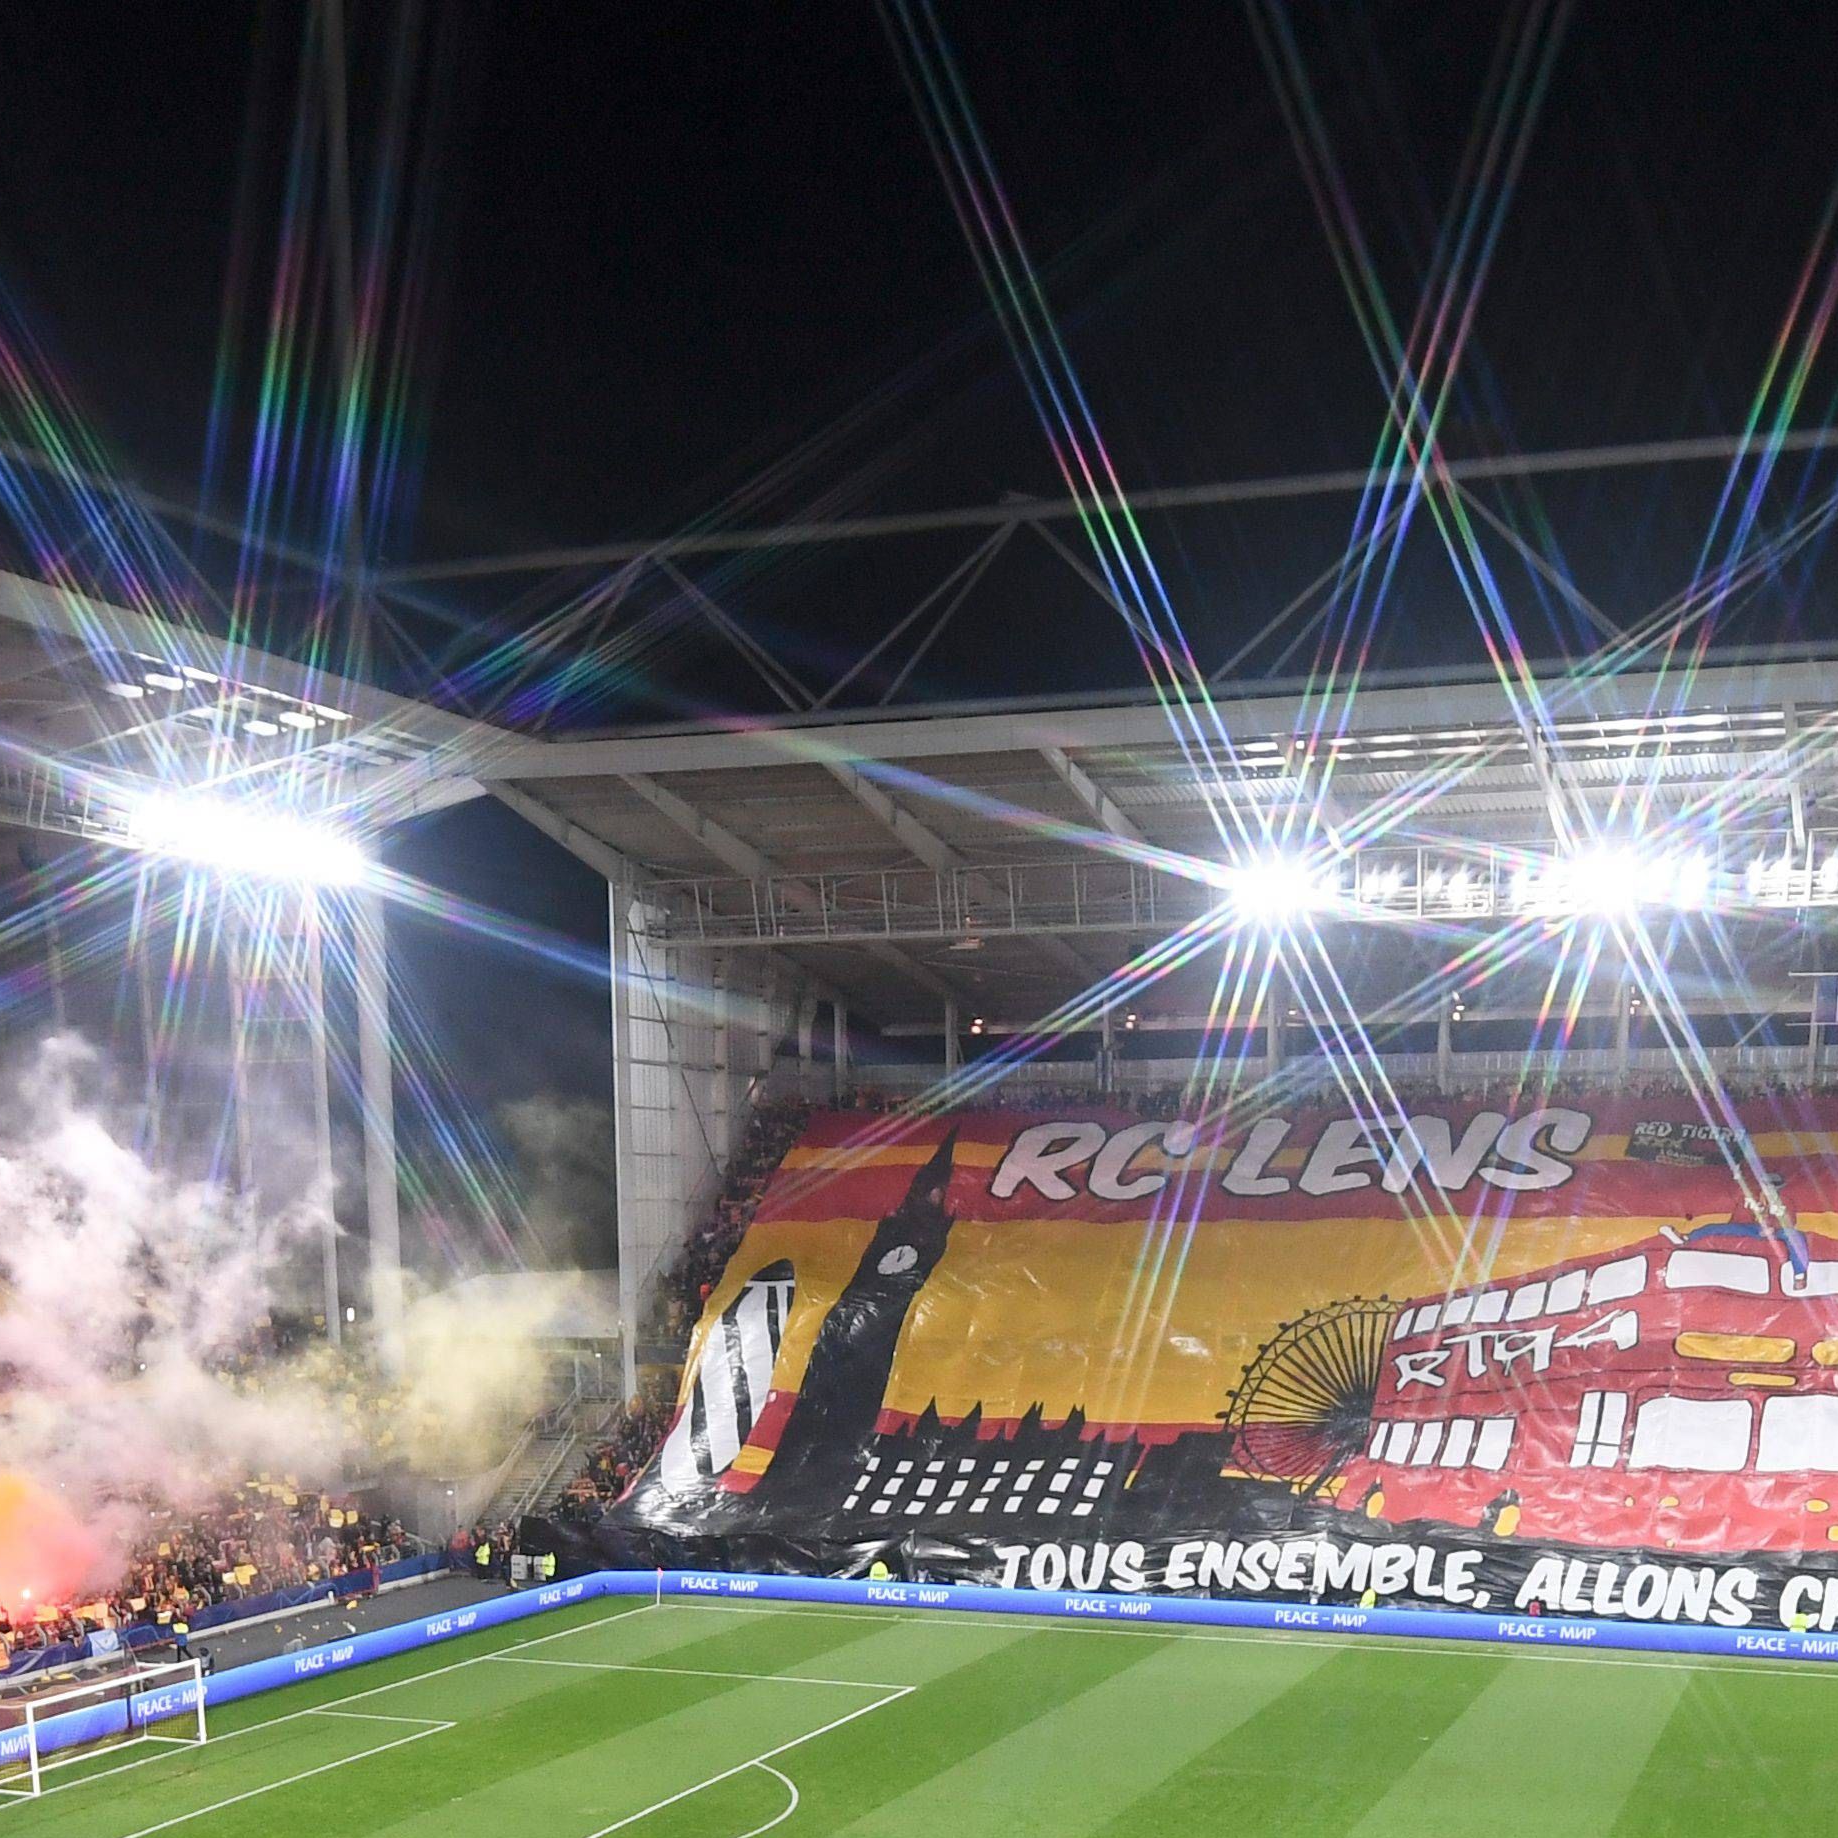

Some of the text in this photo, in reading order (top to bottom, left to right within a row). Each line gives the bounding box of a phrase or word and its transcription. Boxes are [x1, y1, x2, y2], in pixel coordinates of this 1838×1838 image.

[1635, 1121, 1673, 1138] RED
[990, 1107, 1594, 1200] RC LENS
[681, 1576, 719, 1591] PEACE
[994, 1541, 1148, 1592] TOUS
[1163, 1539, 1490, 1611] ENSEMBLE,
[1514, 1556, 1760, 1627] ALLONS
[539, 1591, 561, 1605] PEACE
[867, 1587, 908, 1602] PEACE
[1065, 1598, 1104, 1613] PEACE
[1274, 1610, 1319, 1625] PEACE
[427, 1618, 451, 1636] PEACE
[1498, 1622, 1545, 1638] PEACE
[1736, 1635, 1786, 1652] PEACE
[294, 1653, 324, 1673] PEACE
[137, 1695, 172, 1718] PEACE
